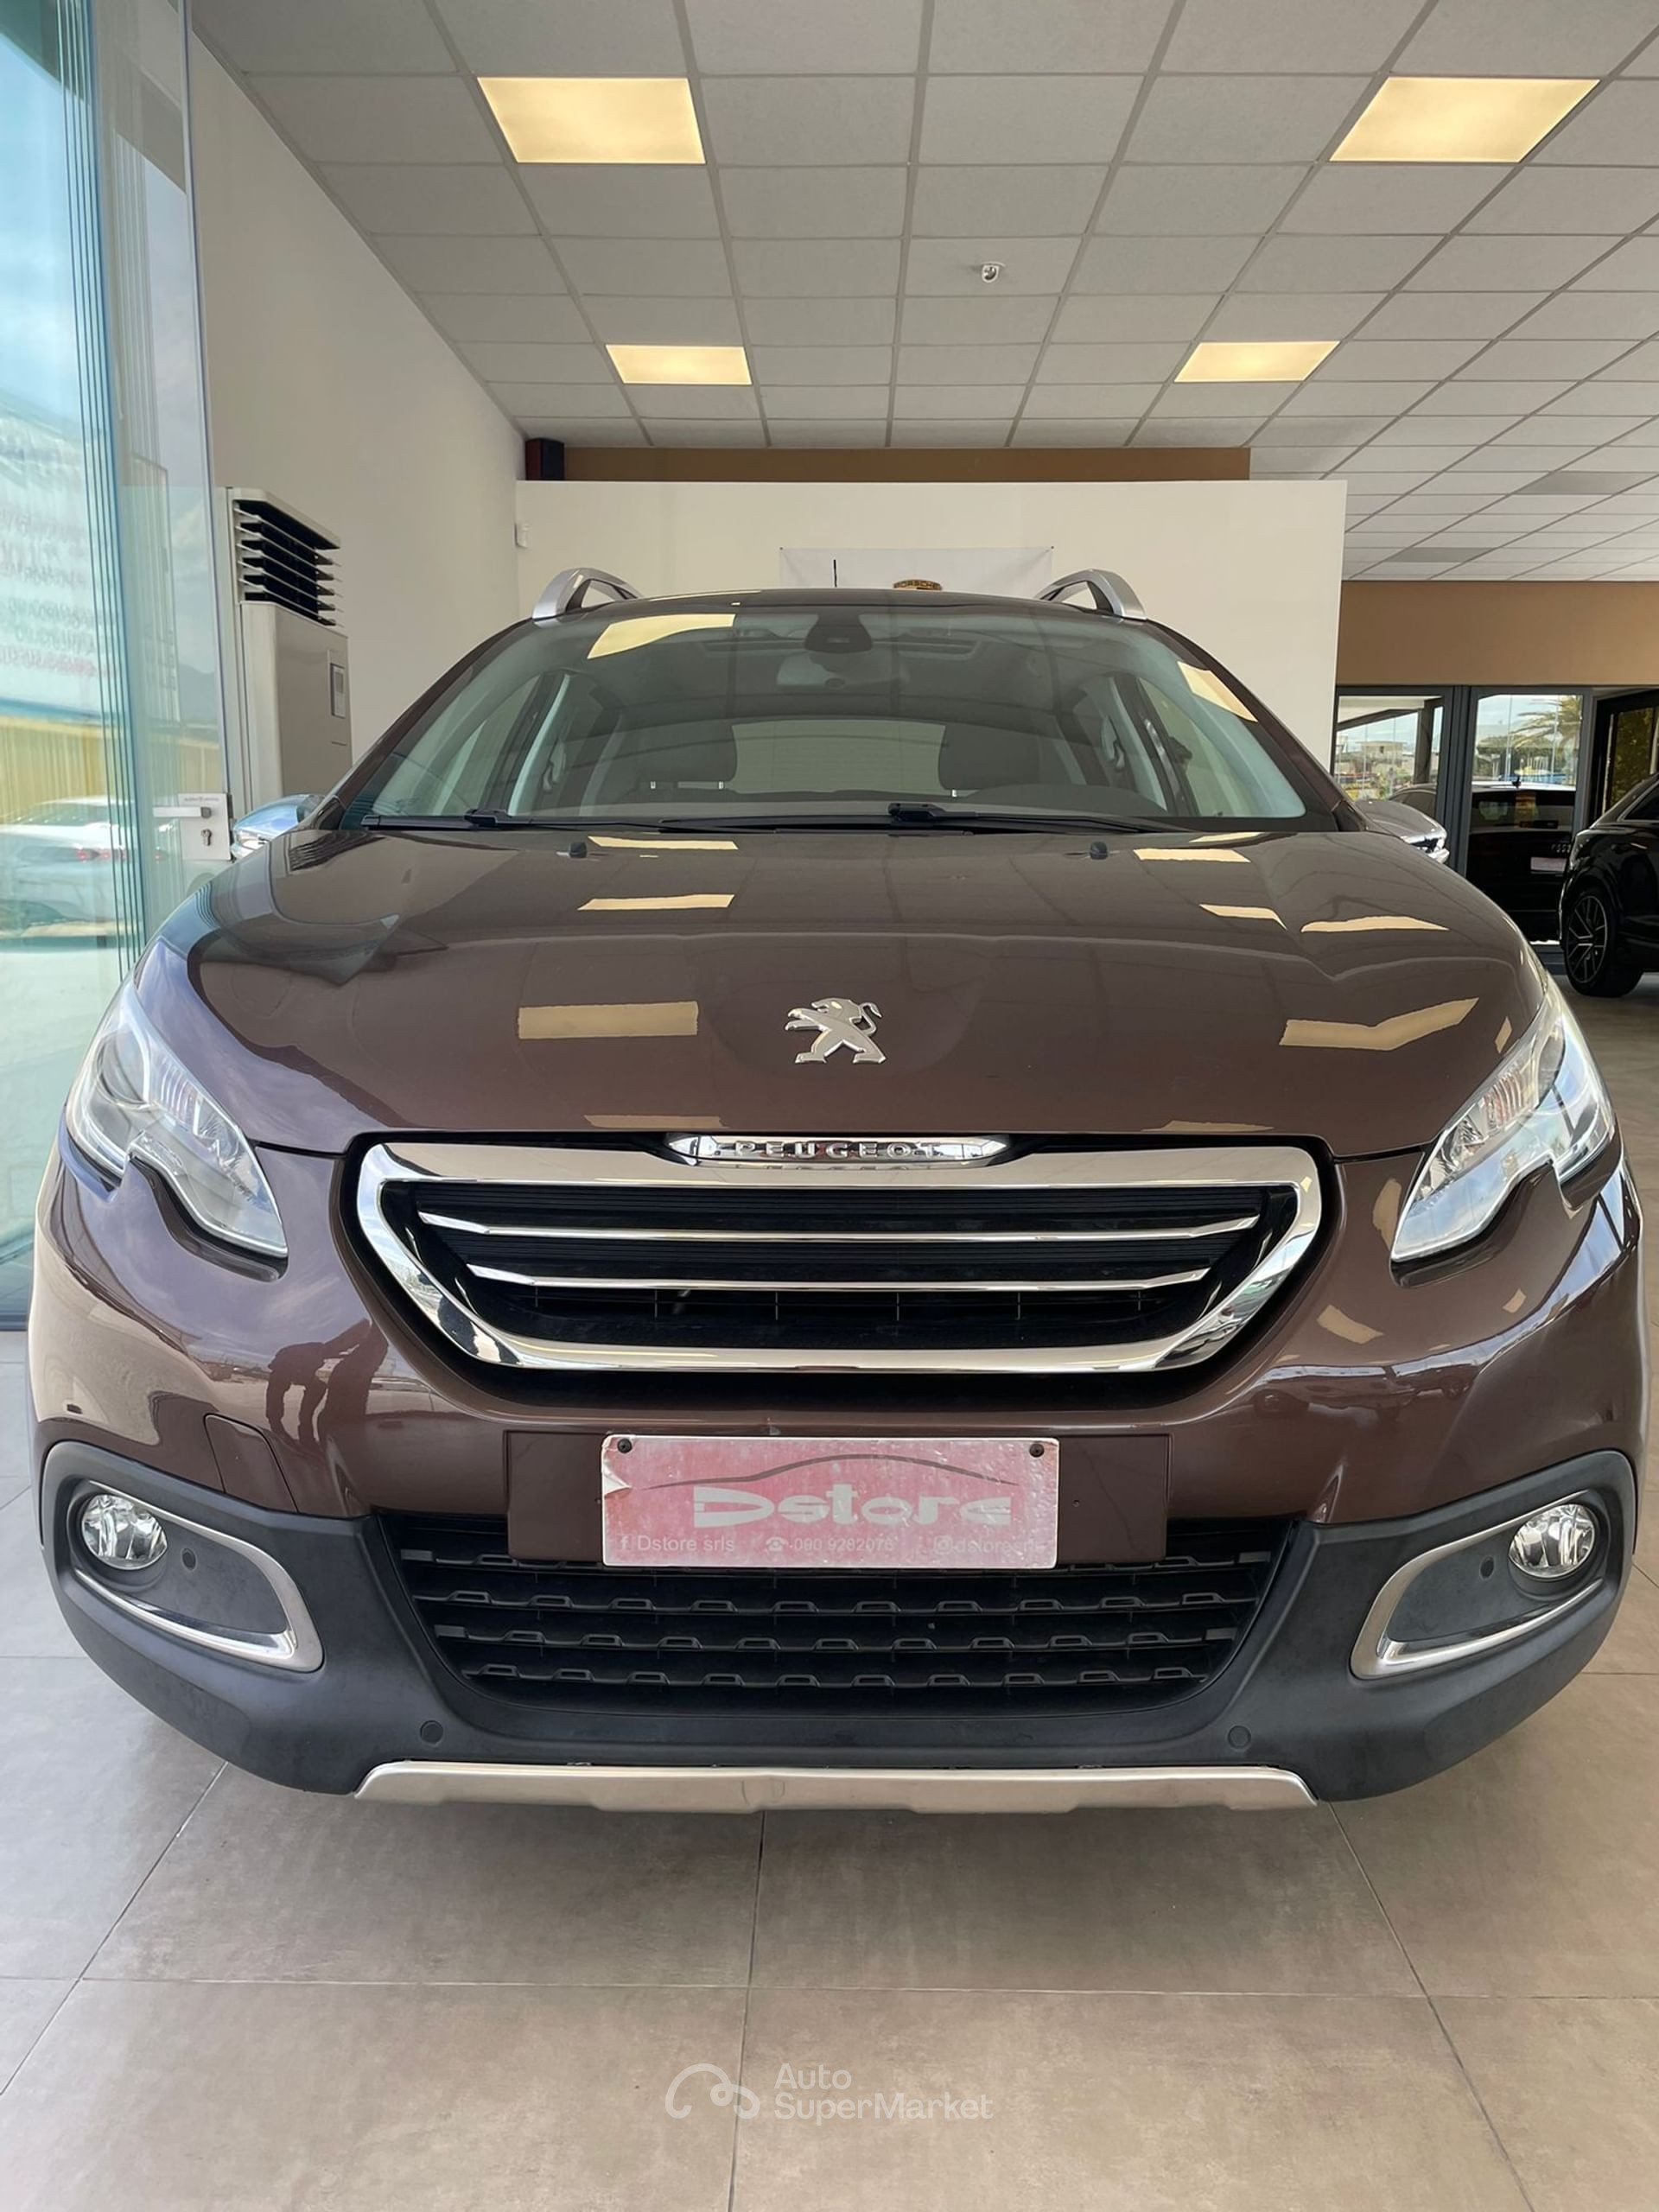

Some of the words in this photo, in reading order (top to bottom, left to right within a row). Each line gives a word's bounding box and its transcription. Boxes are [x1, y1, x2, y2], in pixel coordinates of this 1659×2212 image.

[734, 1140, 941, 1159] PEUGEOT
[693, 1483, 1012, 1528] Dstore
[637, 1535, 696, 1552] Dstore
[703, 1535, 734, 1552] srls
